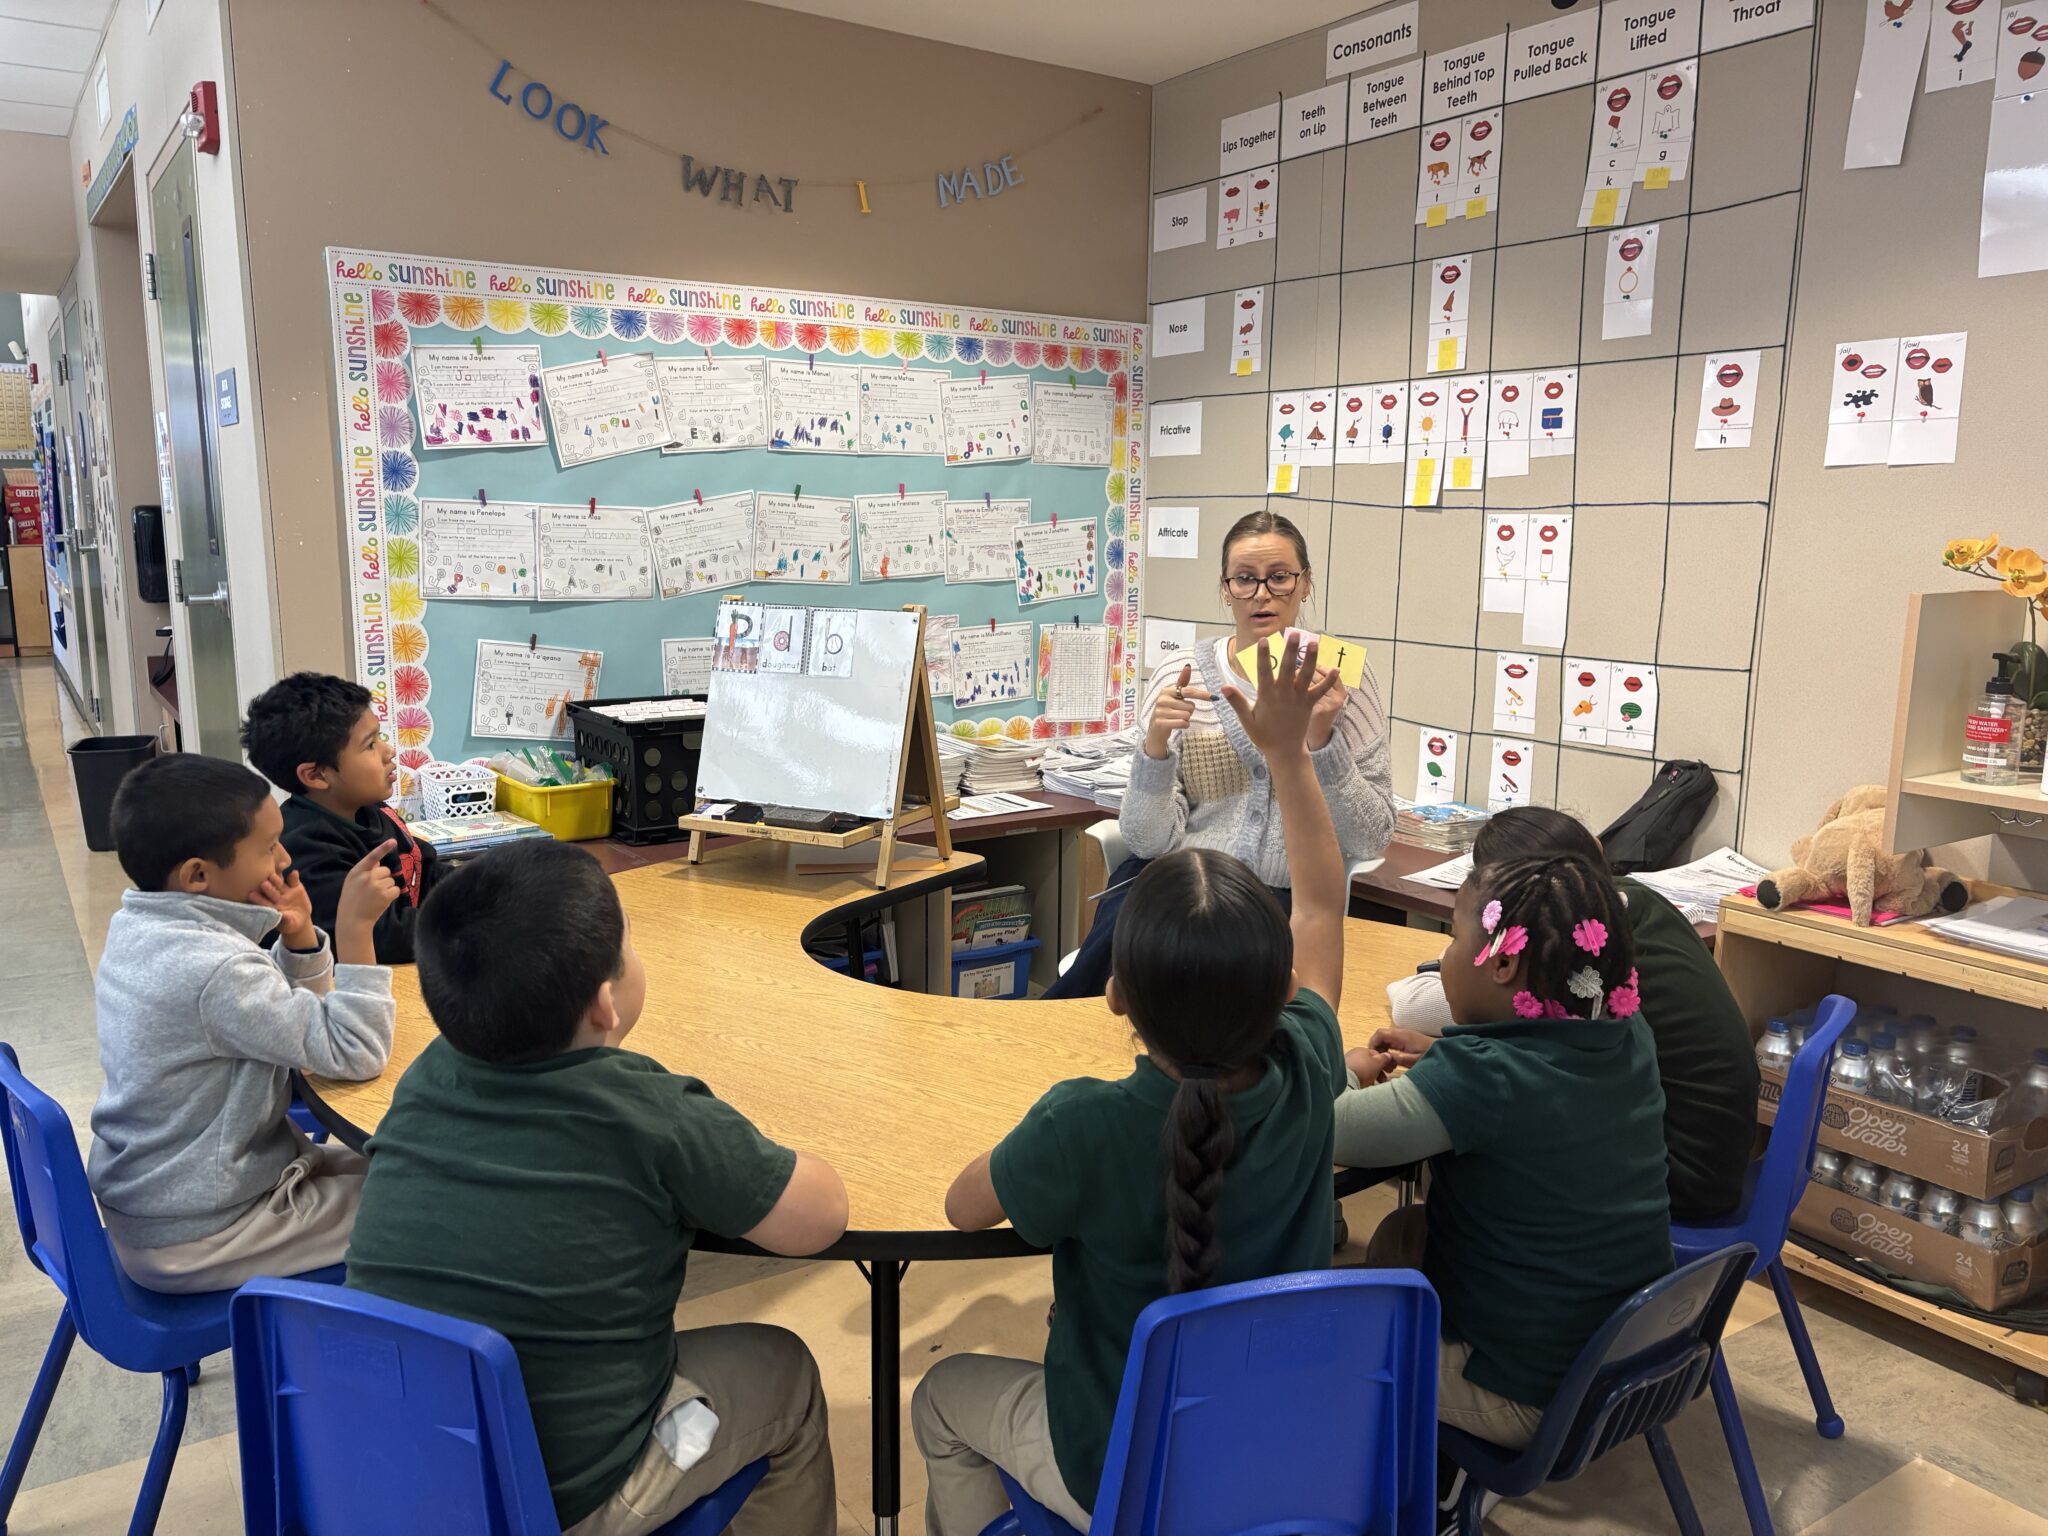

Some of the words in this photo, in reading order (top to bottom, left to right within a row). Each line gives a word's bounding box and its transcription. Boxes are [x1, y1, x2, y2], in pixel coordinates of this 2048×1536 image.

[1624, 7, 1676, 32] Tongue
[1732, 0, 1782, 23] Throat
[1333, 23, 1412, 60] Consonants
[1527, 35, 1575, 58] Tongue
[1630, 28, 1667, 51] Lifted
[1443, 51, 1485, 73] Tongue
[1513, 61, 1551, 82] Pulled
[1555, 51, 1588, 71] Back
[1366, 75, 1404, 95] Tongue
[1433, 72, 1471, 94] Behind
[1474, 67, 1495, 84] Top
[1363, 92, 1407, 114] Between
[1447, 91, 1477, 109] Teeth
[1301, 104, 1326, 121] Teeth
[1370, 112, 1398, 130] Teeth
[489, 59, 610, 156] LOOK
[681, 154, 799, 213] WHAT
[856, 181, 872, 213] I
[938, 155, 1024, 208] MADE
[1223, 141, 1238, 153] Lips
[1239, 129, 1276, 147] Together
[1299, 127, 1311, 139] on
[1313, 122, 1326, 136] Lip
[1609, 159, 1616, 168] c
[1659, 149, 1667, 161] g
[1474, 185, 1481, 194] d
[1606, 176, 1612, 186] k
[1171, 215, 1188, 227] Stop
[1229, 237, 1235, 246] p
[1258, 230, 1264, 238] b
[336, 260, 382, 281] hello
[388, 263, 476, 289] sunshine
[490, 275, 531, 294] hello
[537, 277, 615, 301] sunshine
[628, 286, 664, 304] hello
[670, 288, 741, 310] sunshine
[751, 297, 785, 314] hello
[789, 298, 854, 319] sunshine
[865, 307, 896, 324] hello
[900, 308, 960, 329] sunshine
[969, 317, 998, 333] hello
[1002, 318, 1056, 338] sunshine
[1063, 326, 1089, 341] hello
[344, 292, 368, 381] sunshine
[1169, 323, 1188, 334] Nose
[1132, 328, 1144, 361] hello
[429, 354, 440, 362] My
[568, 373, 582, 381] name
[591, 368, 608, 376] Julian
[1131, 366, 1143, 431] sunshine
[352, 388, 371, 432] hello
[1160, 424, 1191, 436] Fricative
[1720, 434, 1727, 444] h
[1130, 441, 1141, 473] hello
[353, 446, 377, 531] sunshine
[1129, 478, 1141, 541] sunshine
[1158, 527, 1188, 538] Affricate
[362, 537, 380, 580] hello
[1128, 552, 1139, 583] hello
[1127, 587, 1139, 649] sunshine
[362, 592, 386, 676] sunshine
[494, 649, 503, 657] My
[762, 658, 801, 671] doughnut
[1126, 653, 1136, 685] hello
[1849, 1107, 1907, 1136] Open
[1952, 1140, 1969, 1155] 24
[1857, 1212, 1913, 1243] Open
[1955, 1252, 1973, 1267] 24
